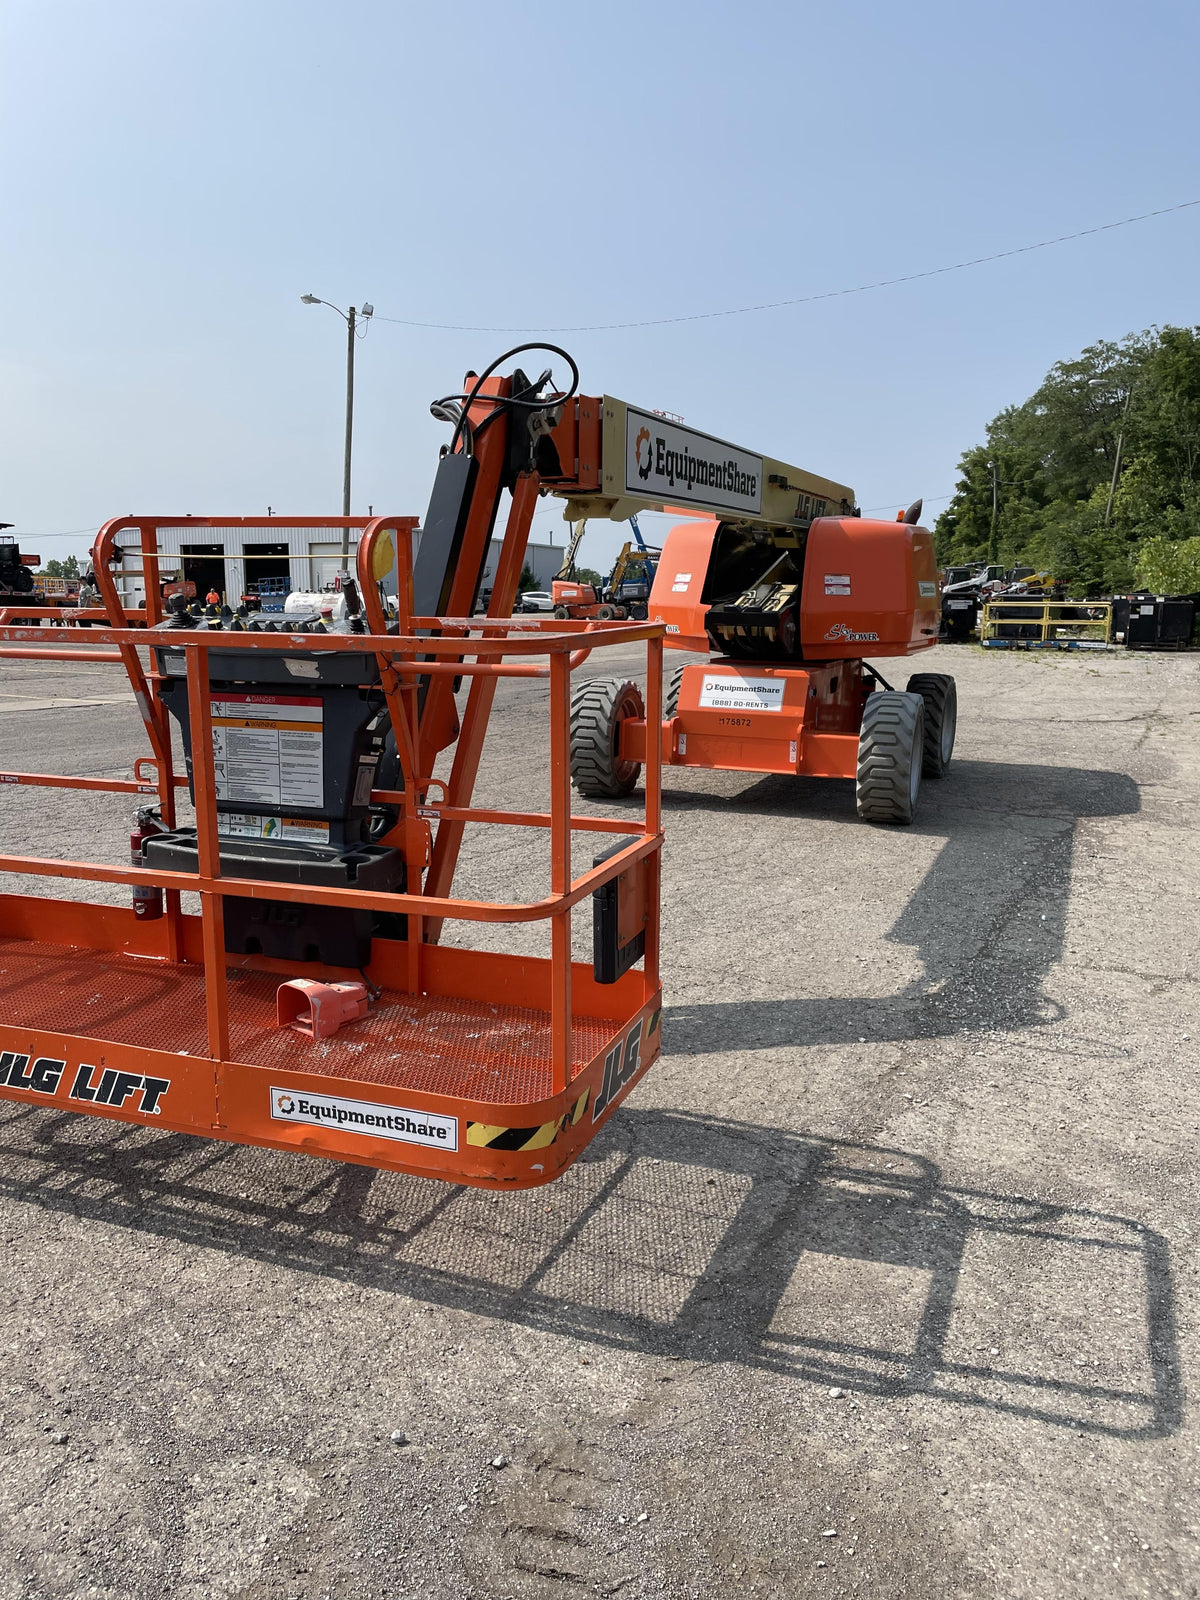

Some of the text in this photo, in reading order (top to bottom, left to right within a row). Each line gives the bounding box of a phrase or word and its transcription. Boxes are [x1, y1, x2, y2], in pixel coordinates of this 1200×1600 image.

[655, 437, 757, 497] EquipmentShare
[714, 684, 780, 694] EquipmentShare
[295, 820, 323, 829] WARNING
[592, 1017, 643, 1124] JLG
[298, 1100, 447, 1140] EquipmentShare
